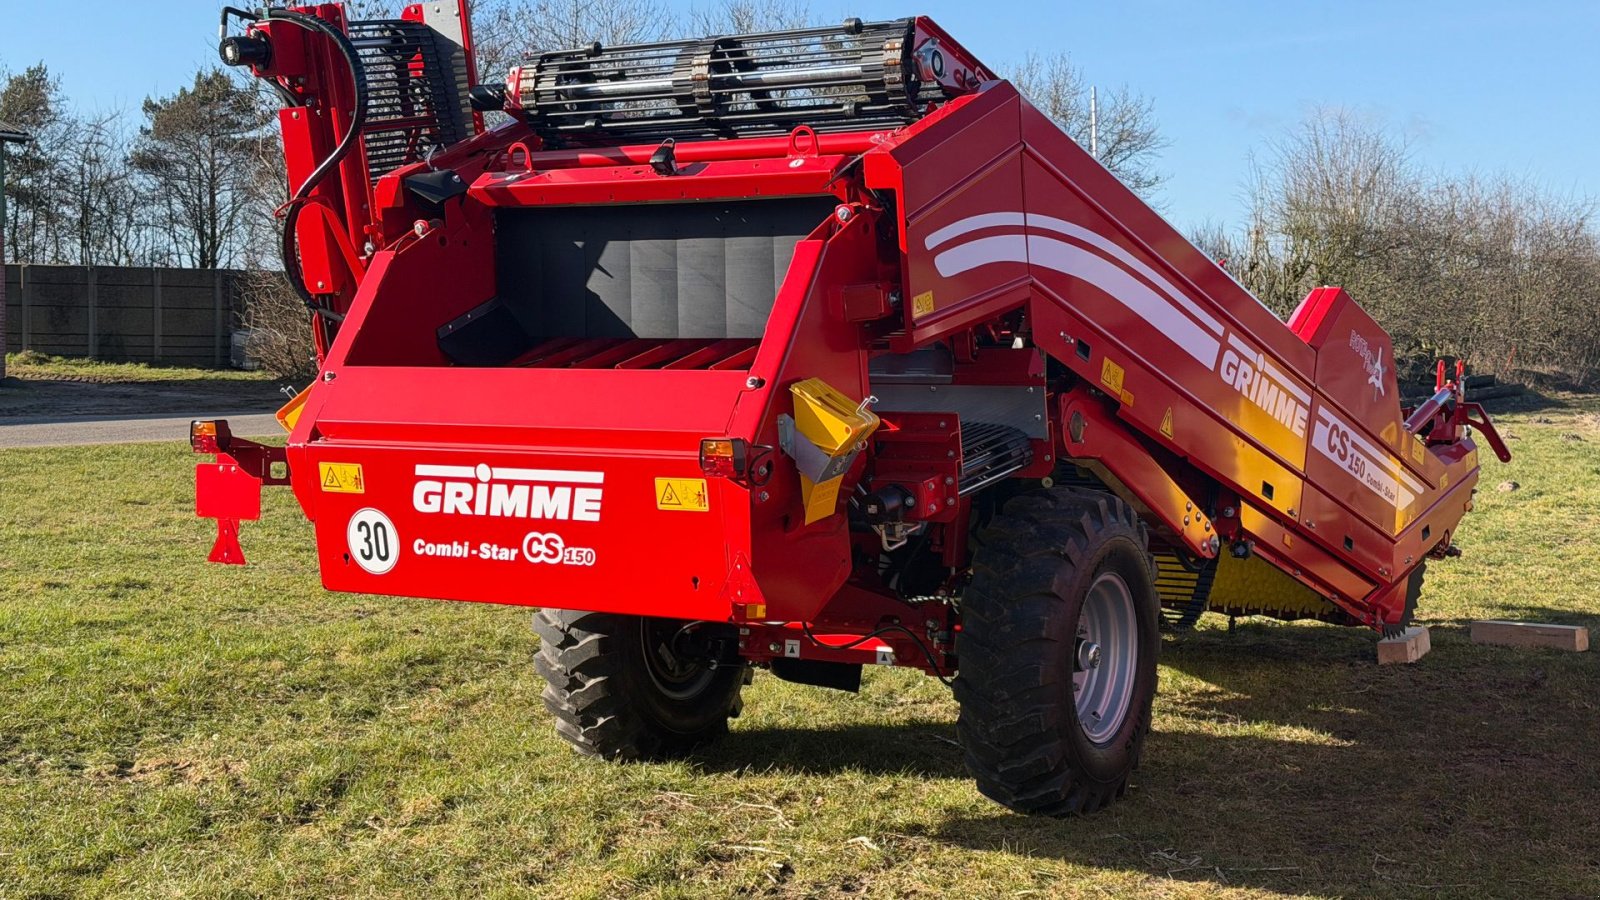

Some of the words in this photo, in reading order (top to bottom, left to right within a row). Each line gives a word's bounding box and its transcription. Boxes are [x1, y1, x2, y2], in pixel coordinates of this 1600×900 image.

[1220, 349, 1309, 439] GRIMME
[1327, 423, 1350, 462] CS
[1348, 453, 1366, 479] 150
[413, 463, 603, 522] GRIMME
[357, 520, 389, 562] 30
[523, 532, 564, 564] CS
[563, 547, 596, 566] 150
